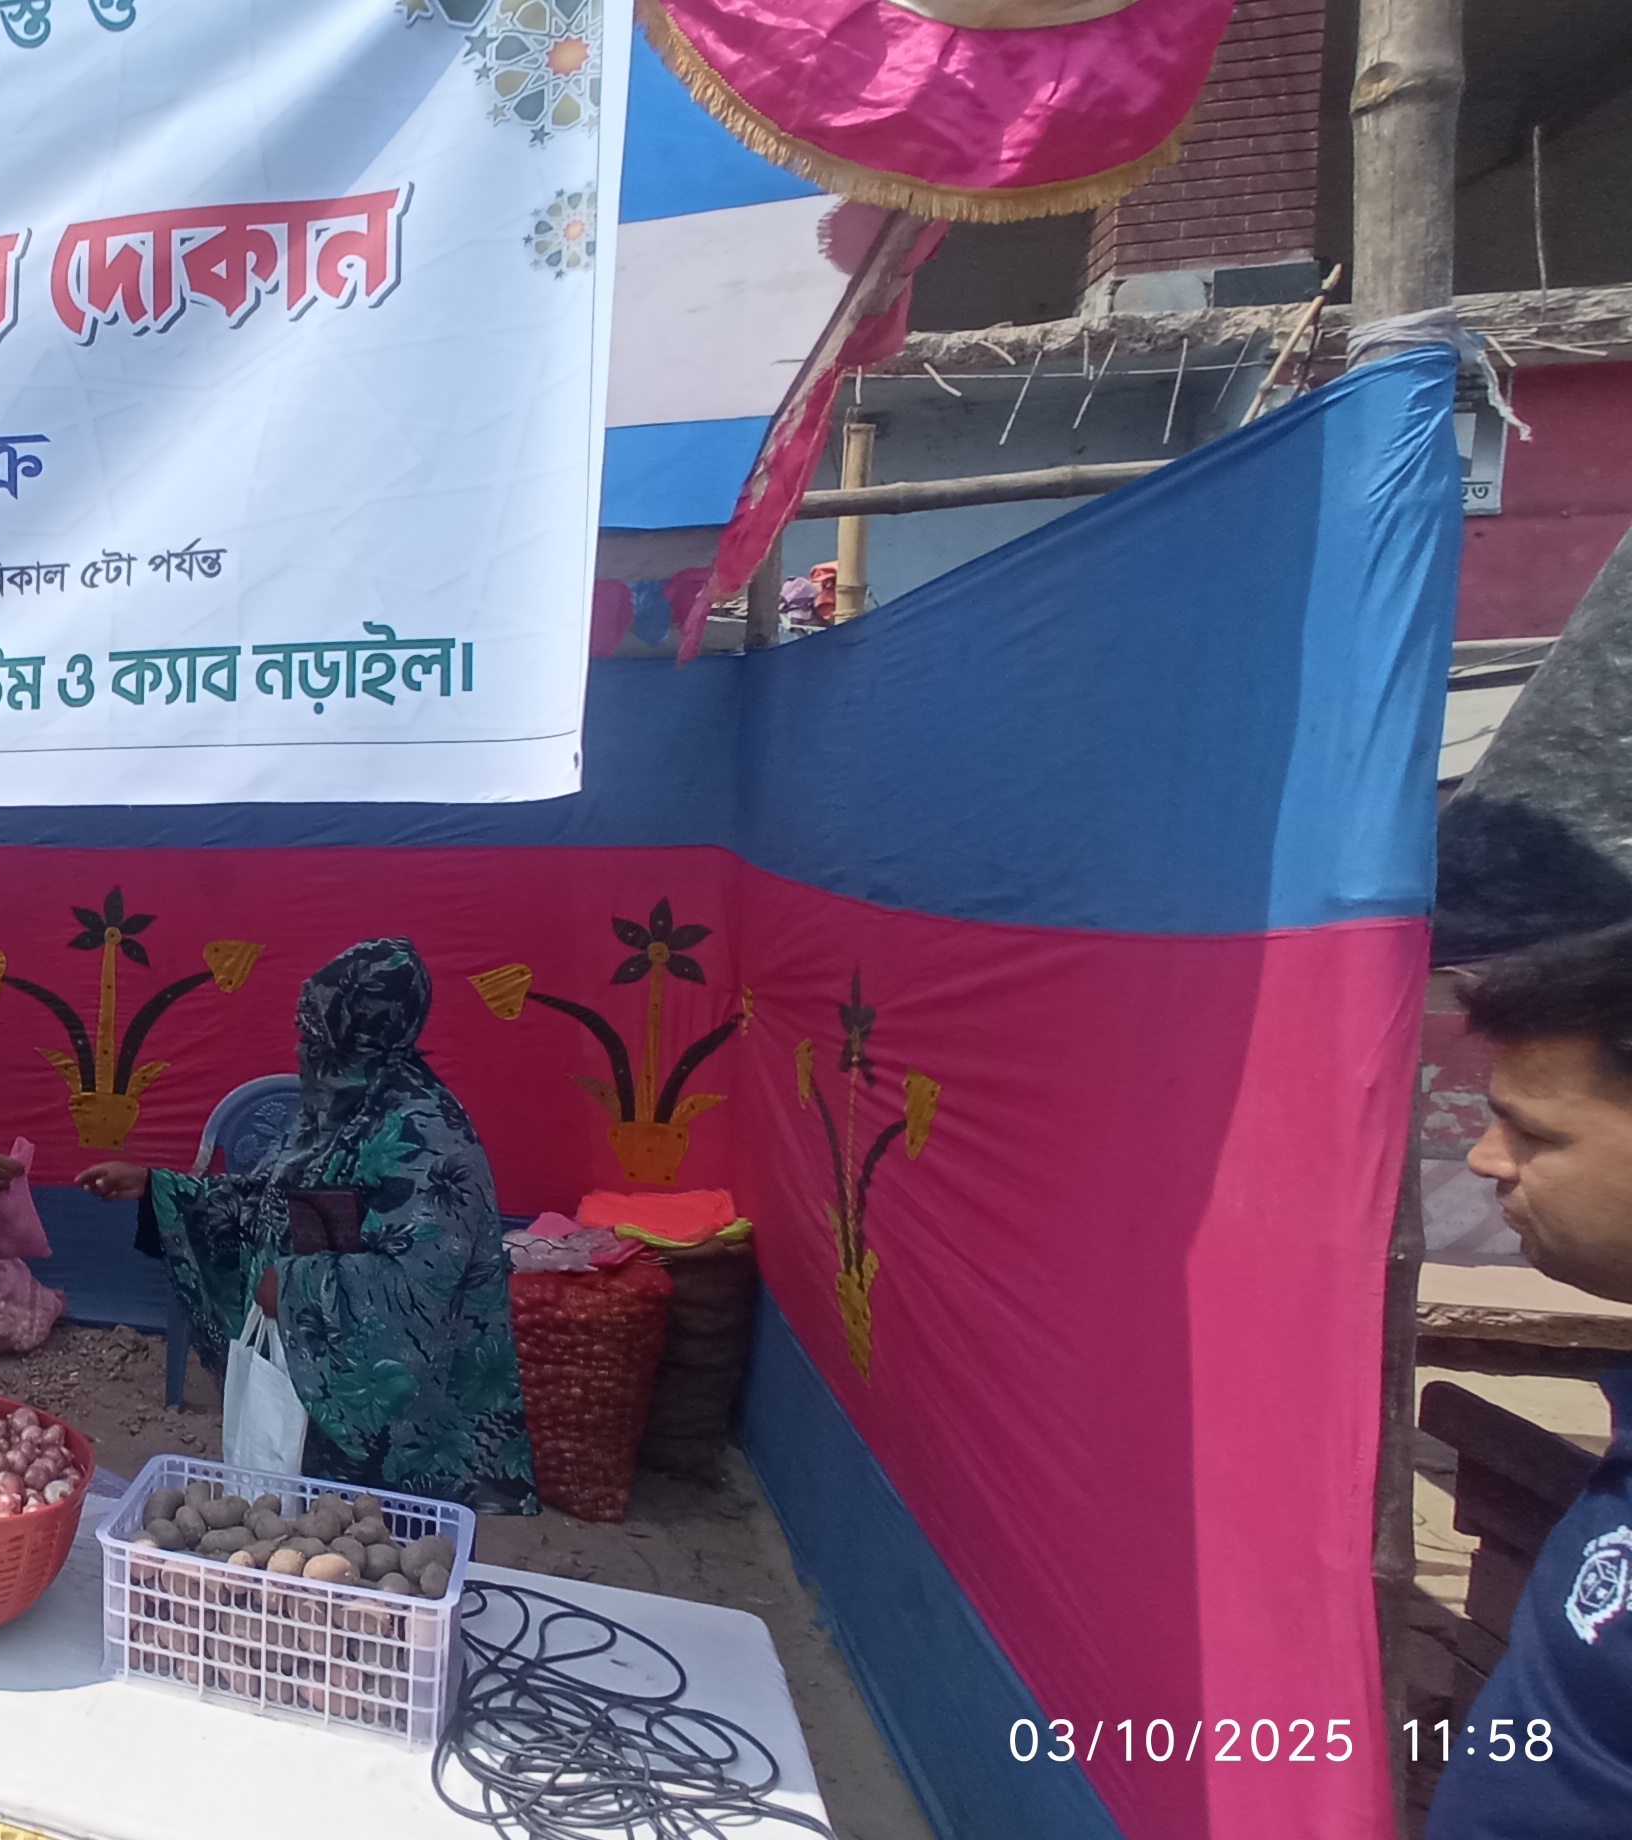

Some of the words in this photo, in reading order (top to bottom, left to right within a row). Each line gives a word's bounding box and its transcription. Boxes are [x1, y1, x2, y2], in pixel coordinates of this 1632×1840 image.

[50, 181, 415, 348] দোকান
[80, 548, 138, 589] ৫টা
[147, 537, 228, 583] পর্যন্ত
[57, 653, 95, 708] ও
[108, 645, 242, 706] ক্যাব
[251, 620, 474, 715] নড়াইল।
